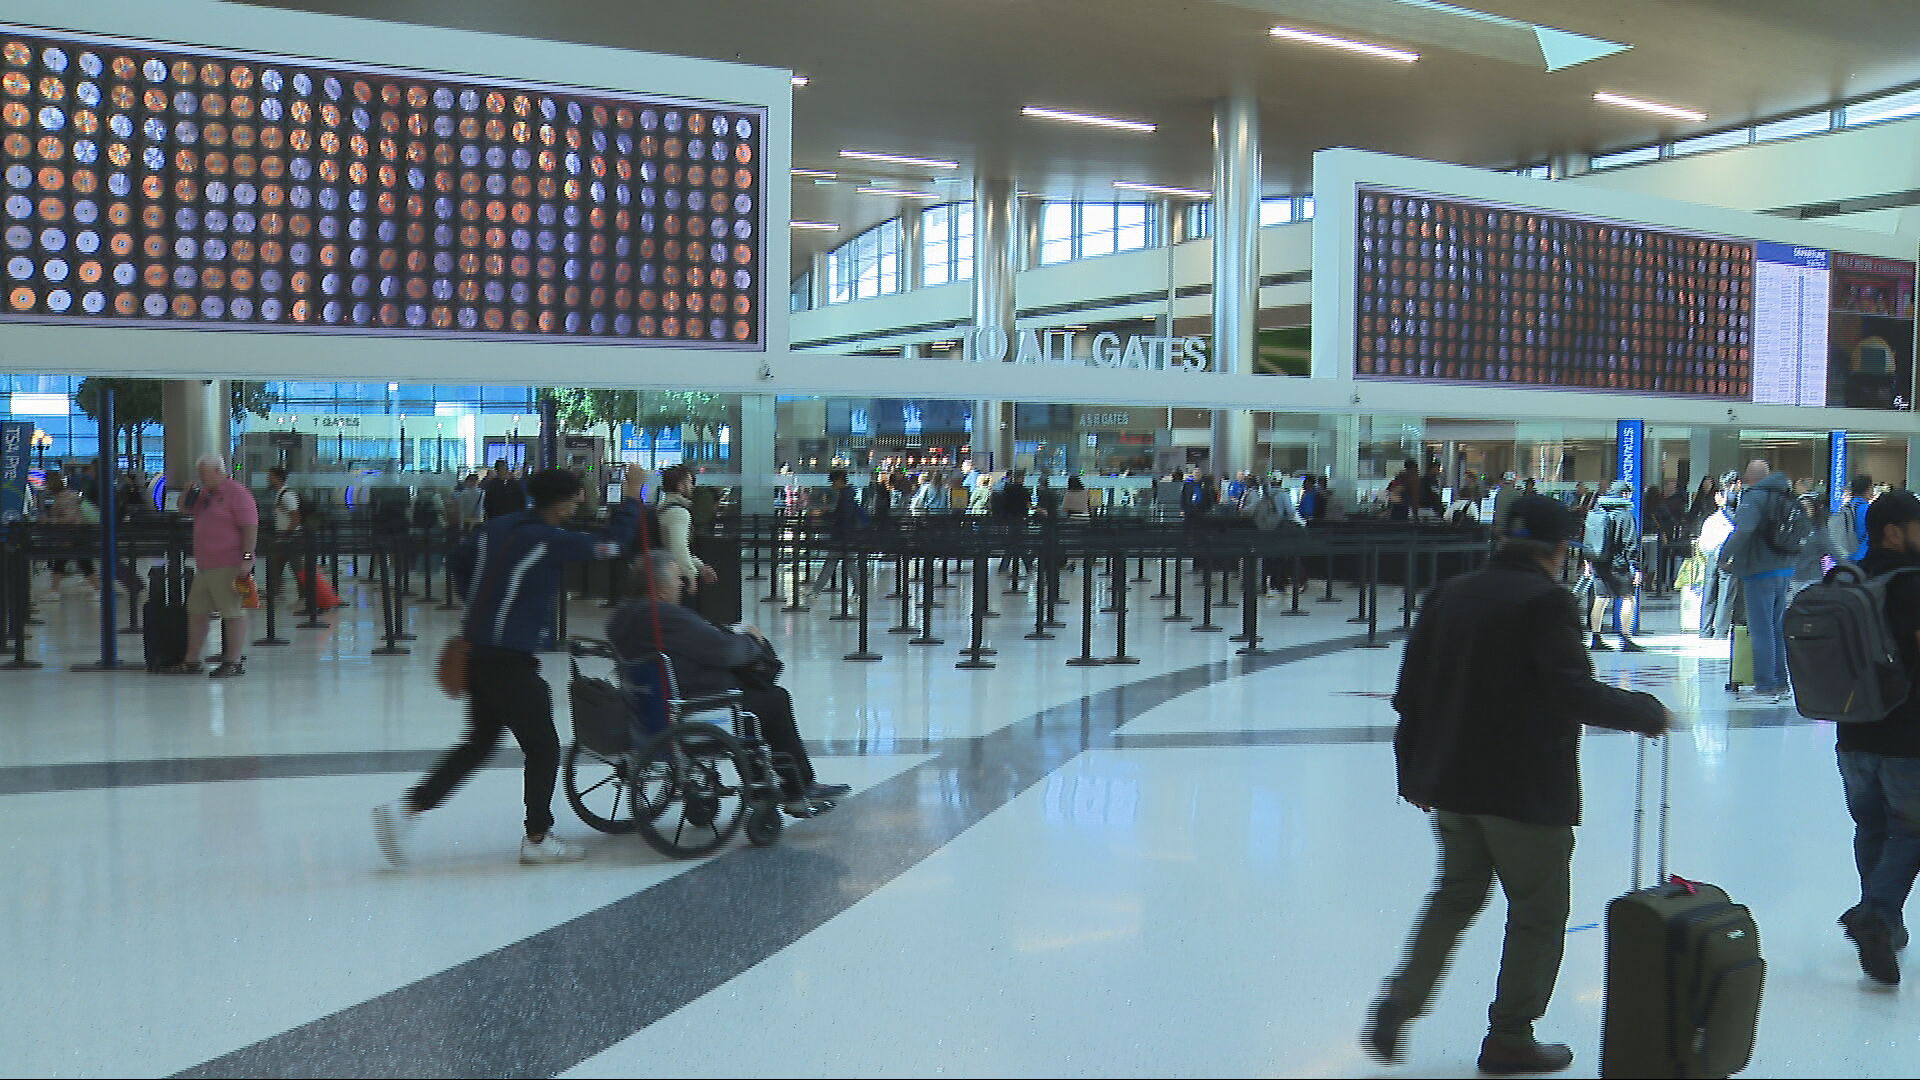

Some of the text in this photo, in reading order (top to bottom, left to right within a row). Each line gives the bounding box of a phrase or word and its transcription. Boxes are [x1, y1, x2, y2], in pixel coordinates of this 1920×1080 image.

[956, 327, 1208, 373] TO ALL GATES
[1102, 412, 1129, 424] GATES
